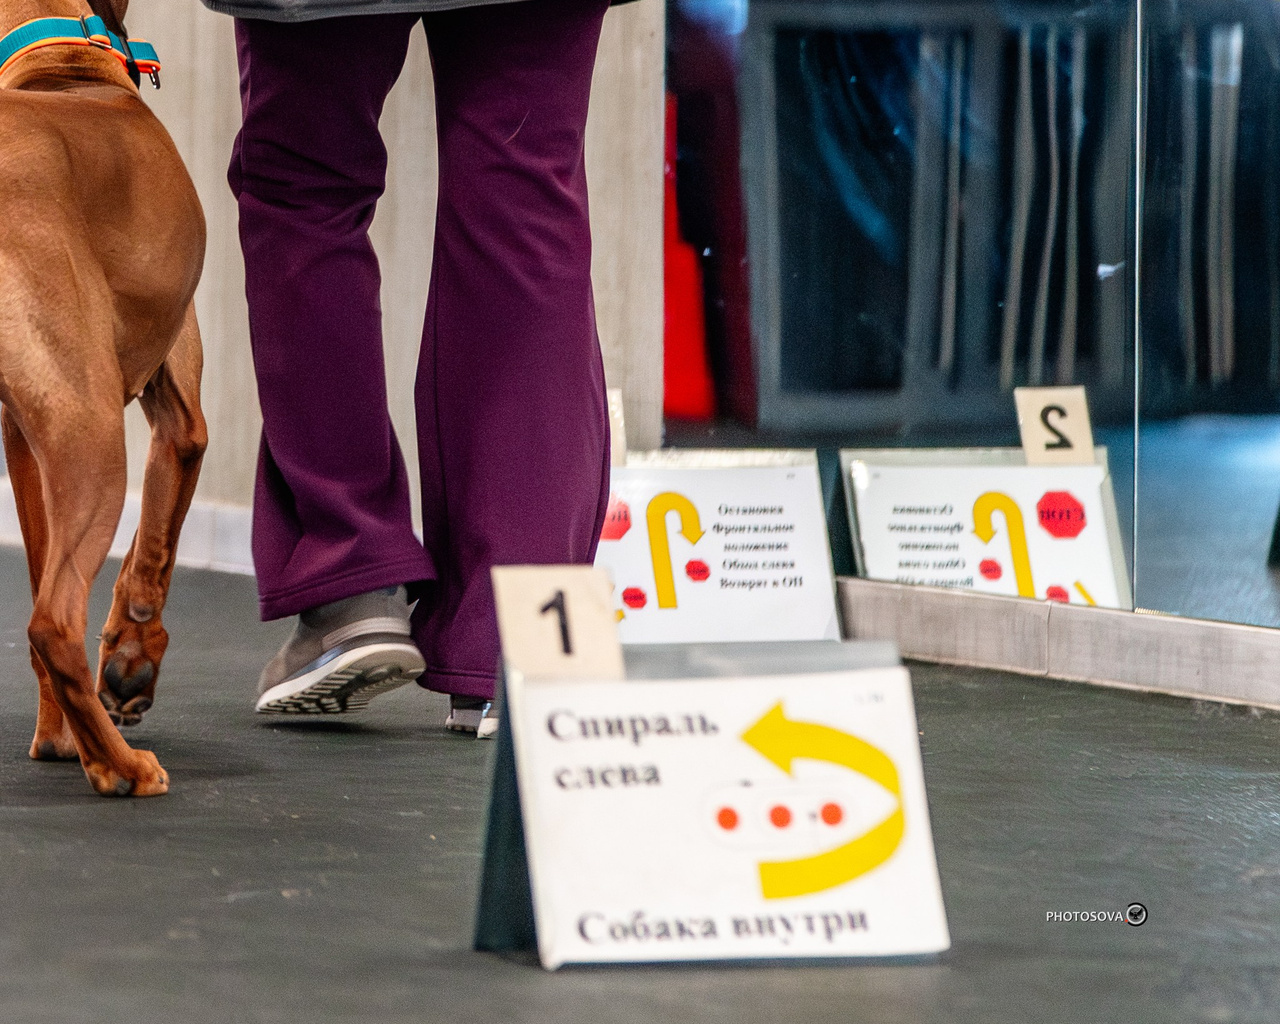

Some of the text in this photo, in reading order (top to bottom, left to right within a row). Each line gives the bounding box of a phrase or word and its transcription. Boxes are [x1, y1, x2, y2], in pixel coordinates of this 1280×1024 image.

[782, 576, 803, 588] ОП
[539, 590, 574, 657] 1
[546, 707, 719, 746] Спираль
[553, 763, 662, 790] слева
[576, 909, 869, 945] Собака внутри
